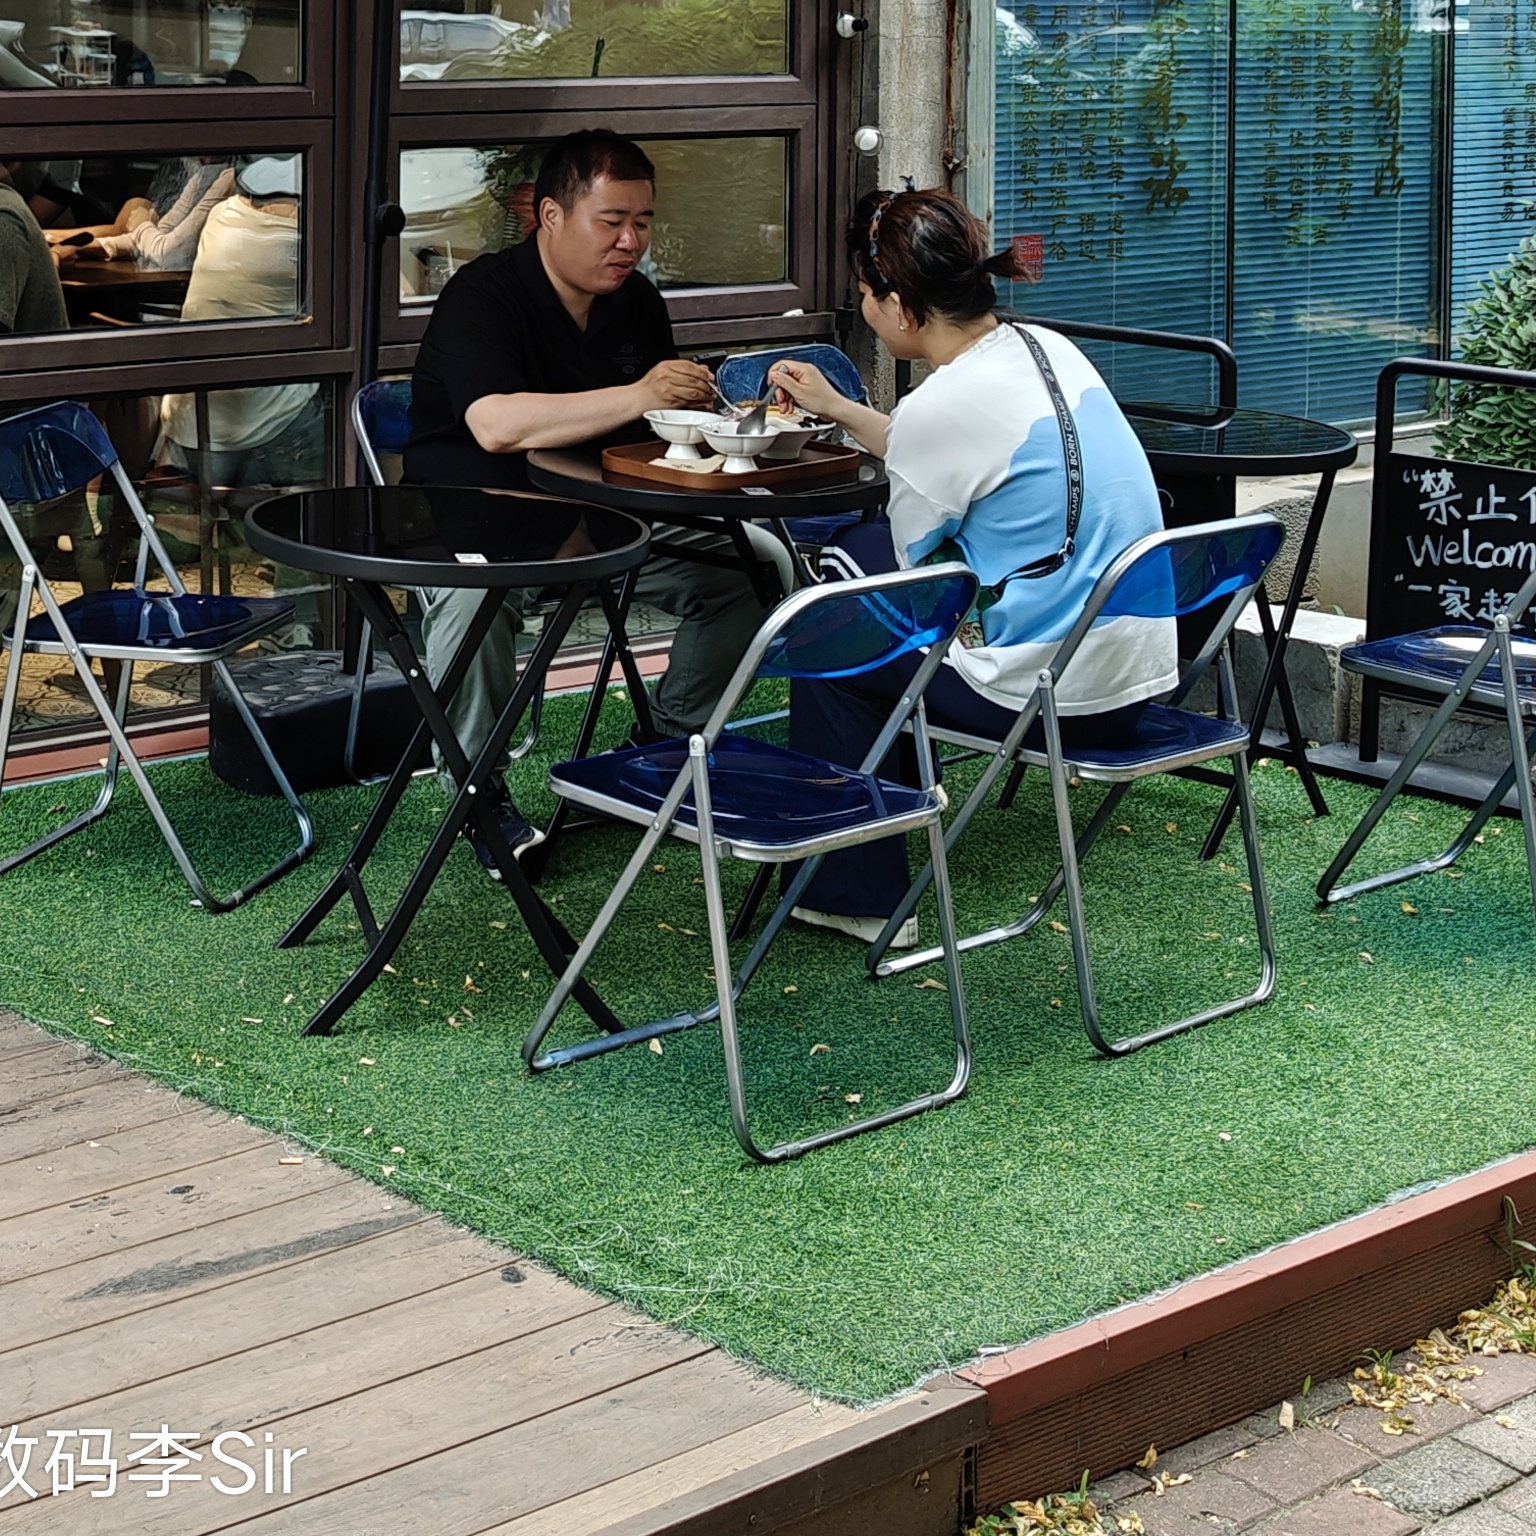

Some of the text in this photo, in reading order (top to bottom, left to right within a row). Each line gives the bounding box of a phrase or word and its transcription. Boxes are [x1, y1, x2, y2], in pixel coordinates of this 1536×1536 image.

[1054, 392, 1074, 429] CHAMPS
[1067, 428, 1078, 467] BORN
[1068, 486, 1080, 533] CHAMPS
